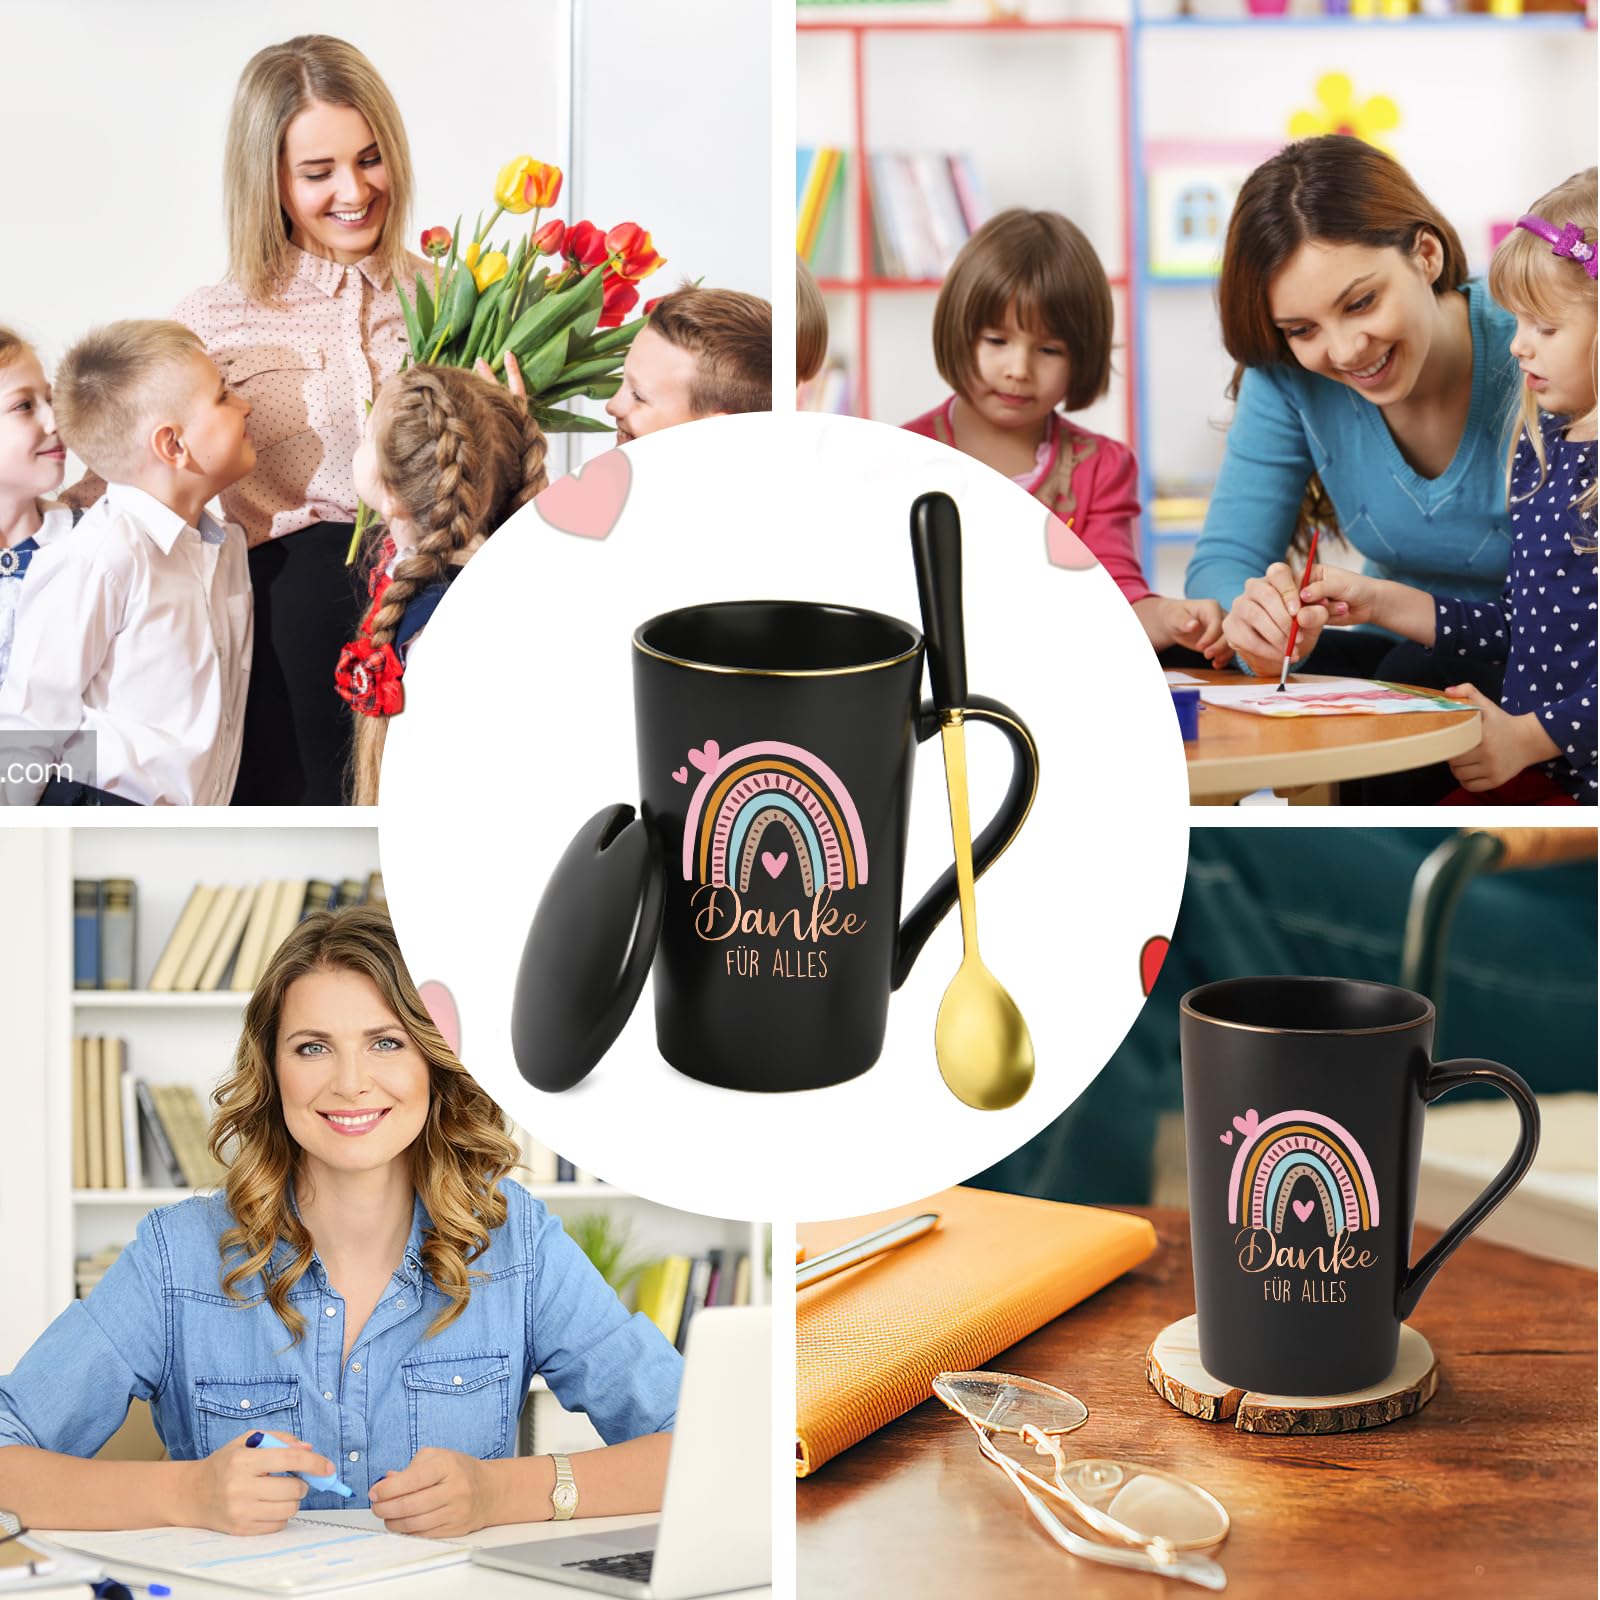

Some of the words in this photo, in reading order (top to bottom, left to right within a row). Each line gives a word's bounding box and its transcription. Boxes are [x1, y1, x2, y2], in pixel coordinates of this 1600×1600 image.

[690, 883, 867, 943] Danke
[726, 945, 759, 979] FÜR
[772, 948, 828, 979] ALLES
[1234, 1226, 1379, 1274] Danke
[1263, 1276, 1291, 1304] FÜR
[1301, 1279, 1347, 1303] ALLES
